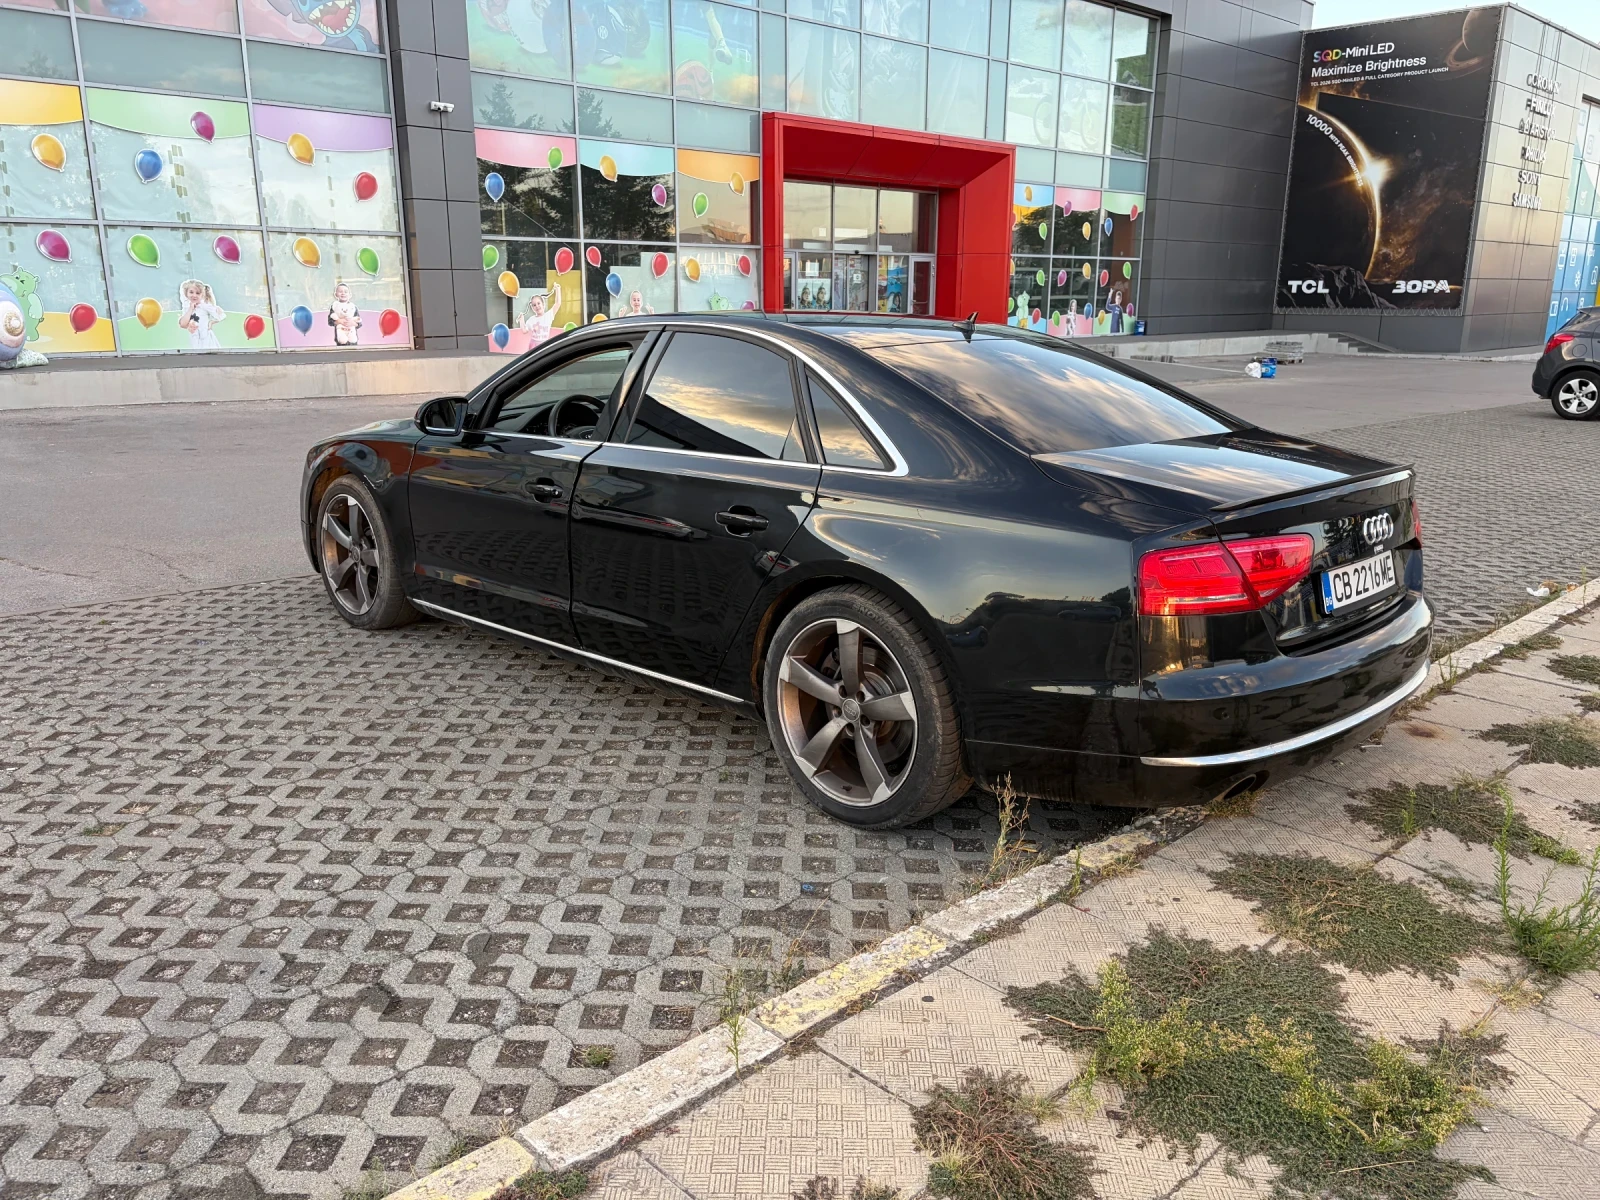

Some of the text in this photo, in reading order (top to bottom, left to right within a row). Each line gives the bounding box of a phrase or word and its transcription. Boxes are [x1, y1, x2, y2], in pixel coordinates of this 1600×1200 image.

[1311, 57, 1426, 78] Maximize Brightness
[1377, 72, 1403, 80] CATEGORY
[1306, 114, 1333, 135] 10000
[1520, 170, 1542, 186] SONY
[1287, 280, 1329, 294] TCL
[1392, 279, 1450, 294] ЗОРА
